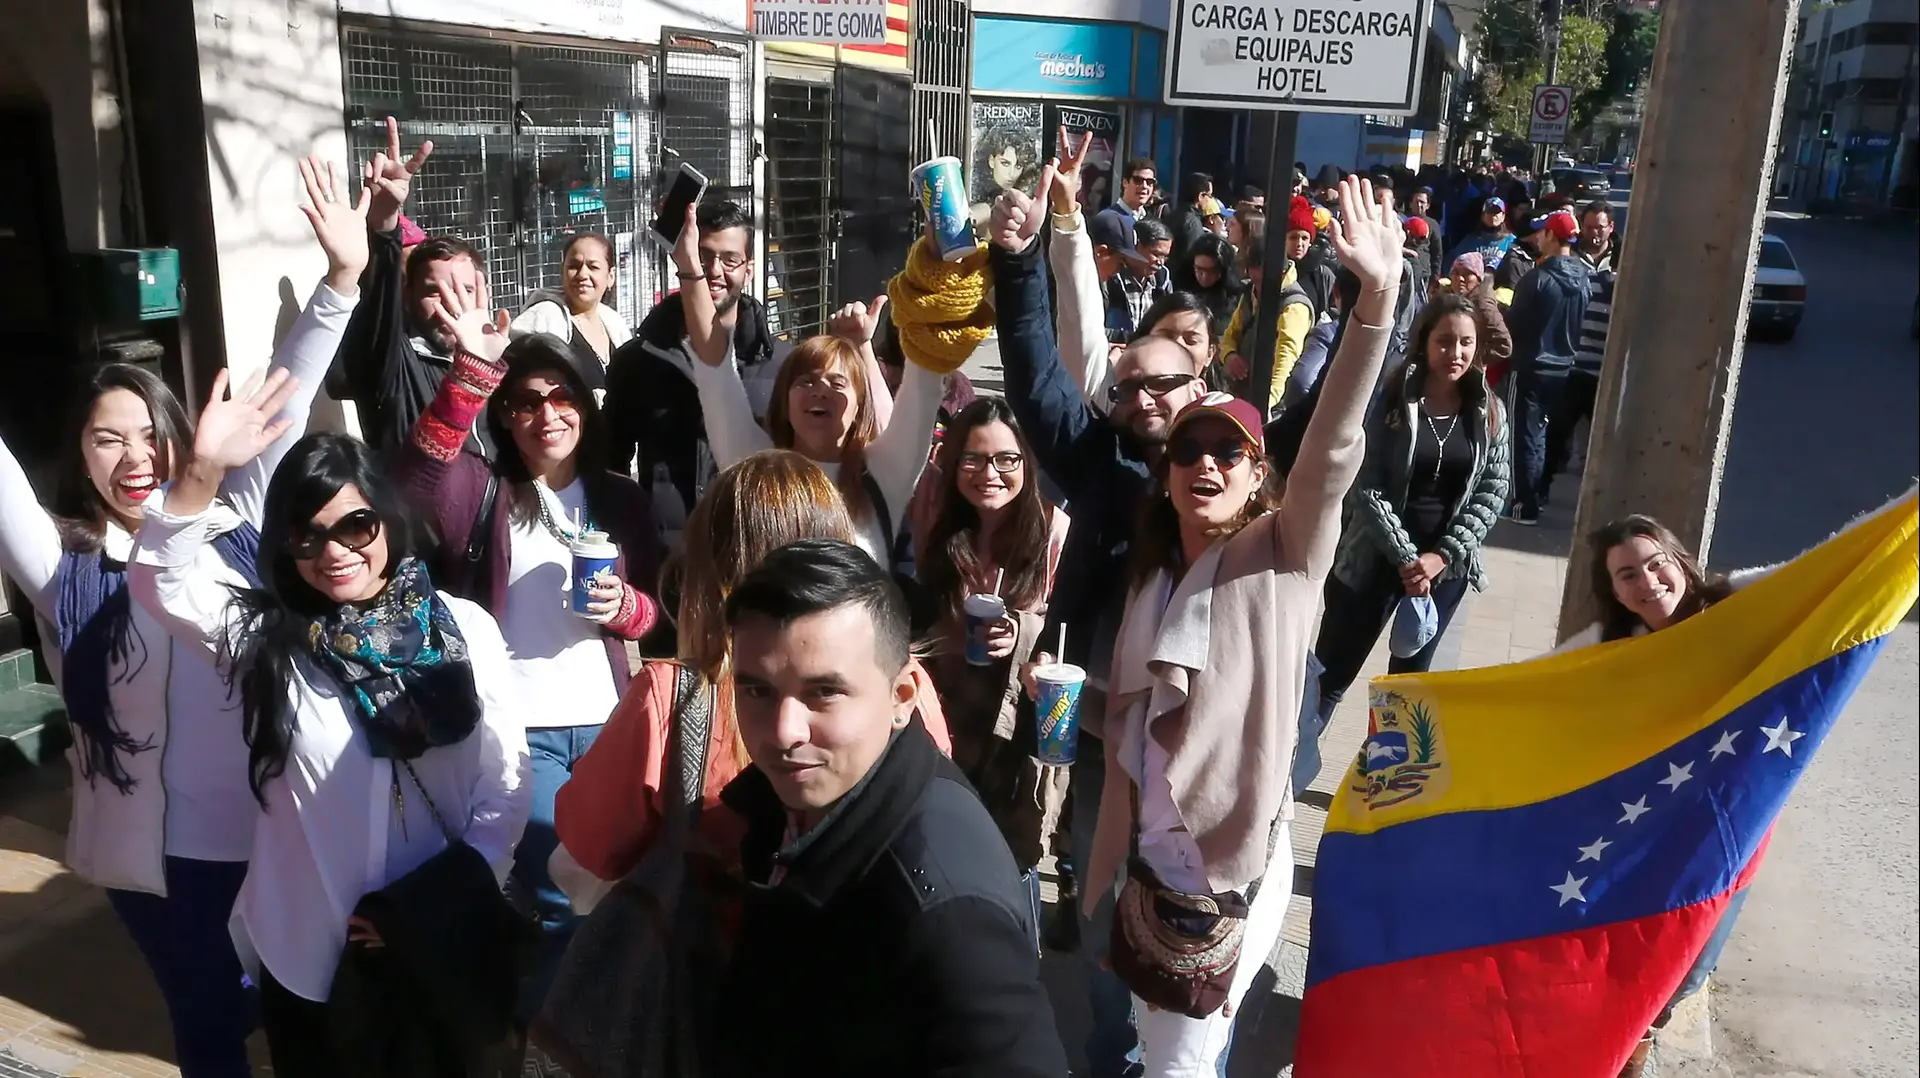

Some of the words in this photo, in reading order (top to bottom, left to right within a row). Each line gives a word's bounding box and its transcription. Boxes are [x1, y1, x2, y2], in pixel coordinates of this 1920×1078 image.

[753, 11, 808, 36] TIMBRE
[813, 12, 833, 37] DE
[838, 12, 884, 38] GOMA
[1192, 4, 1267, 31] CARGA
[1275, 8, 1284, 32] Y
[1293, 8, 1413, 37] DESCARGA
[1235, 36, 1353, 65] EQUIPAJES
[1040, 54, 1106, 78] mecha's
[1257, 67, 1327, 93] HOTEL
[982, 106, 1032, 119] REDKEN
[1061, 111, 1115, 131] REDKEN
[1041, 690, 1071, 739] SUBWAY
